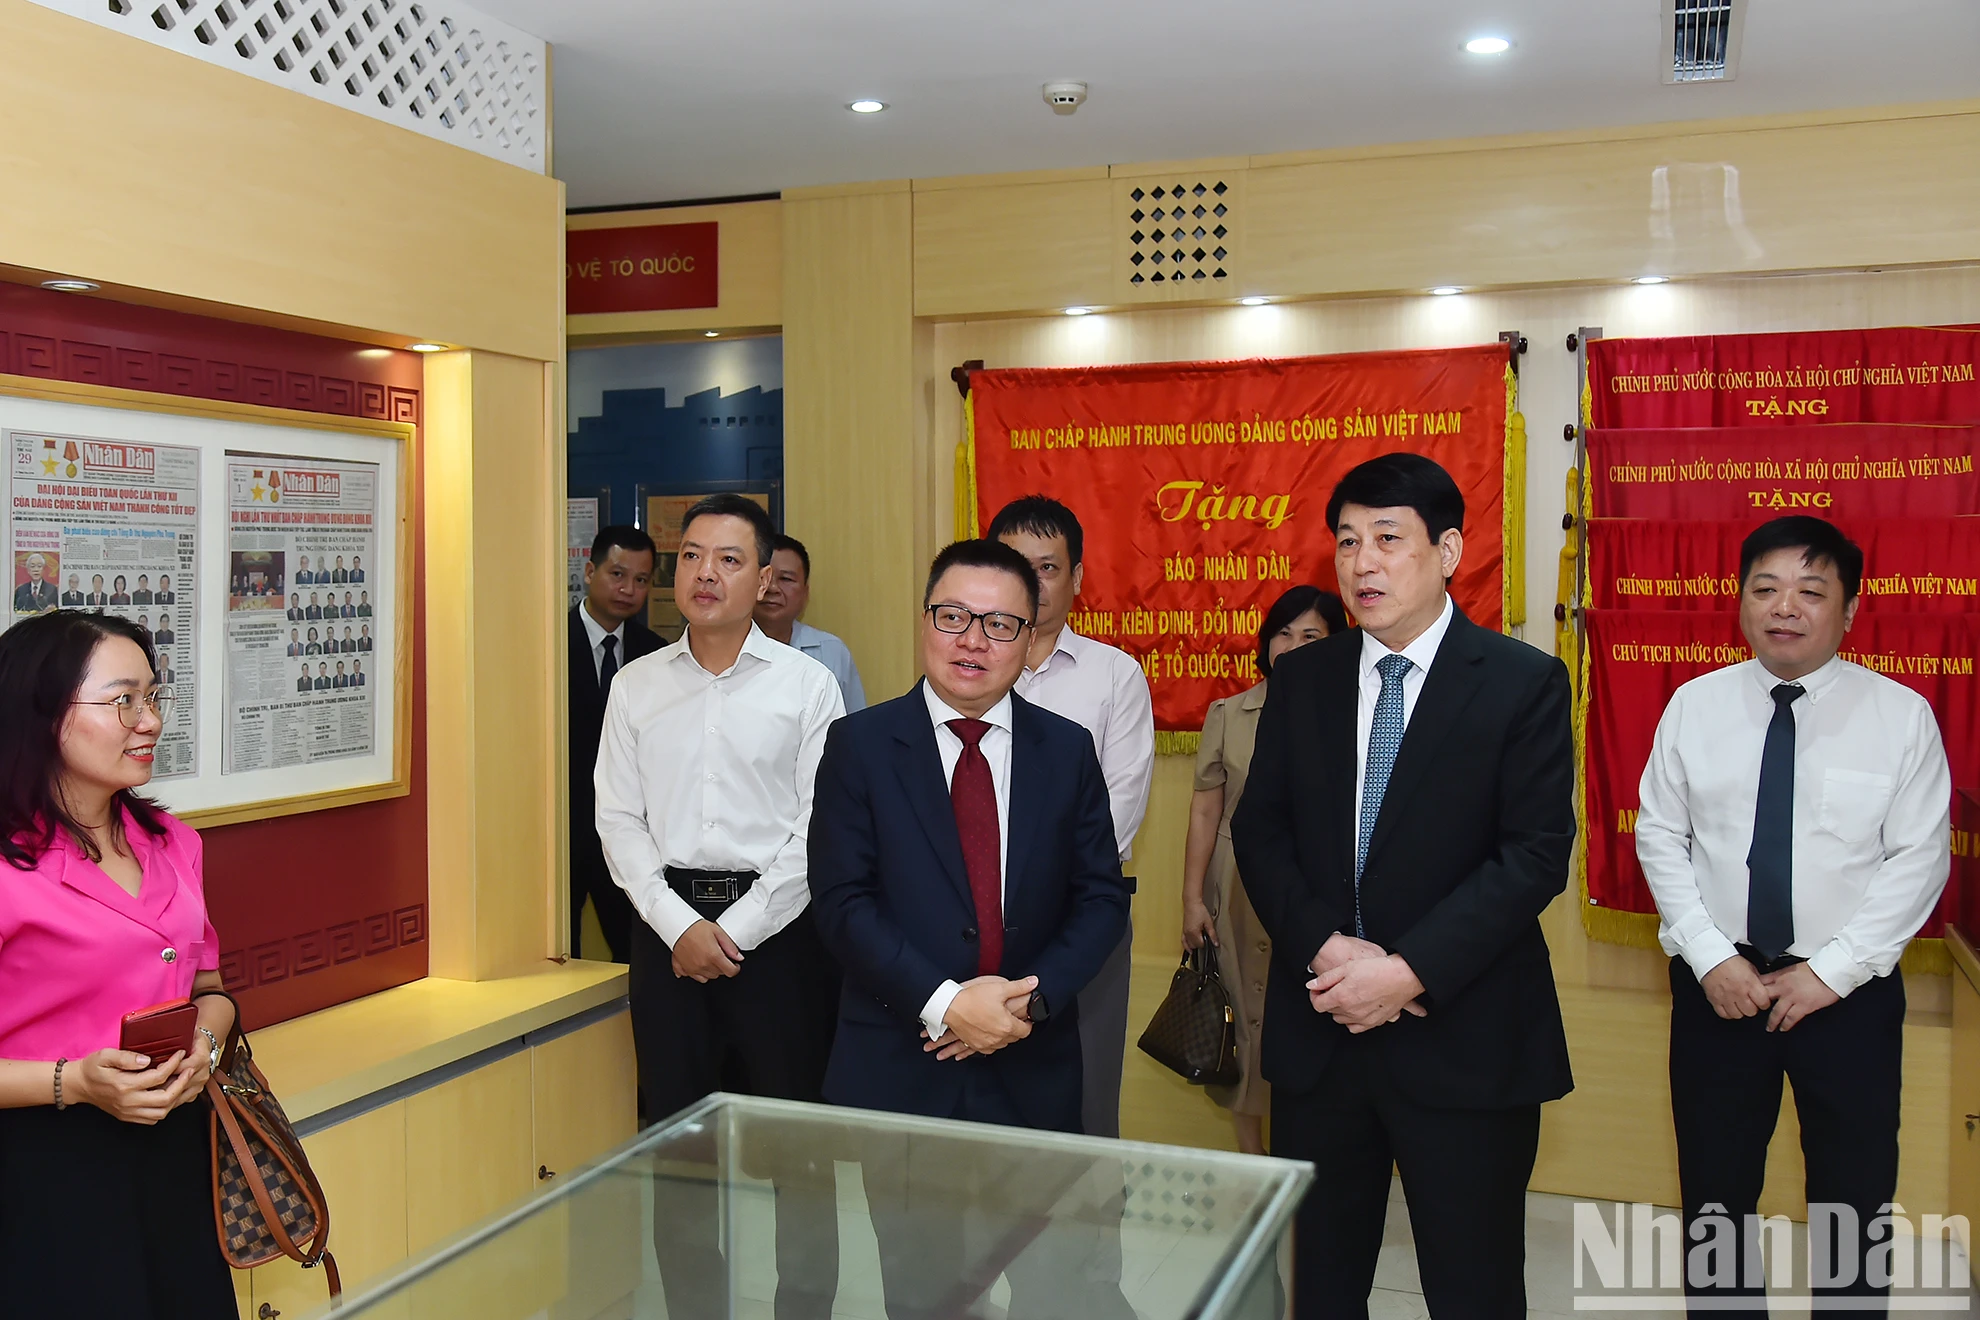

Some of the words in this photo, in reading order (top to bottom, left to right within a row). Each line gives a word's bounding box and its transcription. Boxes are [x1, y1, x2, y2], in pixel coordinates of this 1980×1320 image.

[577, 257, 601, 281] VỆ
[640, 249, 695, 275] QUỐC
[1611, 370, 1650, 394] CHÍNH
[1653, 367, 1679, 392] PHỦ
[1682, 367, 1716, 391] NƯỚC
[1718, 368, 1752, 393] CỘNG
[1755, 364, 1783, 388] HÒA
[1785, 365, 1803, 388] XÃ
[1805, 364, 1830, 390] HỘI
[1832, 360, 1861, 386] CHỦ
[1862, 363, 1905, 385] NGHĨA
[1907, 361, 1939, 387] VIỆT
[1942, 364, 1975, 382] NAM
[1746, 395, 1829, 419] TẶNG
[1010, 429, 1040, 450] BAN
[1045, 419, 1084, 449] CHẤP
[1088, 422, 1130, 447] HÀNH
[1134, 423, 1186, 445] TRUNG
[1191, 421, 1236, 445] ƯƠNG
[1240, 412, 1286, 443] ĐẢNG
[1291, 413, 1337, 446] CỘNG
[1343, 407, 1377, 438] SẢN
[1382, 408, 1418, 441] VIỆT
[1423, 412, 1461, 435] NAM
[18, 453, 32, 464] 29
[84, 443, 123, 467] Nhân
[126, 447, 153, 469] Dân
[1609, 461, 1647, 483] CHÍNH
[1650, 458, 1676, 483] PHỦ
[1679, 456, 1714, 482] NƯỚC
[1717, 458, 1751, 484] CỘNG
[1755, 457, 1782, 479] HÒA
[1784, 458, 1801, 479] XÃ
[1805, 458, 1829, 484] HỘI
[1832, 455, 1860, 480] CHỦ
[1863, 458, 1906, 479] NGHĨA
[1908, 453, 1941, 481] VIỆT
[1943, 455, 1974, 475] NAM
[284, 473, 314, 491] Nhân
[316, 474, 339, 492] Dân
[1157, 480, 1294, 531] Tặng
[1748, 488, 1833, 510] TẶNG
[1165, 550, 1195, 581] BÁO
[1204, 550, 1248, 581] NHÂN
[1257, 549, 1290, 580] DÂN
[1616, 573, 1653, 596] CHÍNH
[1656, 572, 1681, 597] PHỦ
[1684, 572, 1718, 596] NƯỚC
[1721, 573, 1739, 599] CỘ
[1867, 573, 1909, 595] NGHĨA
[1911, 572, 1944, 599] VIỆT
[1946, 578, 1977, 595] NAM
[1121, 605, 1153, 635] KIÊN
[1158, 610, 1198, 638] ĐỊNH,
[1203, 597, 1228, 636] ĐỔI
[1140, 648, 1159, 684] VỆ
[1164, 640, 1183, 678] TỔ
[1188, 642, 1230, 678] QUỐC
[1234, 649, 1265, 685] VIỆ
[1641, 644, 1671, 666] TỊCH
[1674, 641, 1711, 663] NƯỚC
[1714, 643, 1748, 666] CỘNG
[1861, 650, 1906, 674] NGHĨA
[1905, 653, 1940, 678] VIỆT
[1942, 657, 1973, 675] NAM
